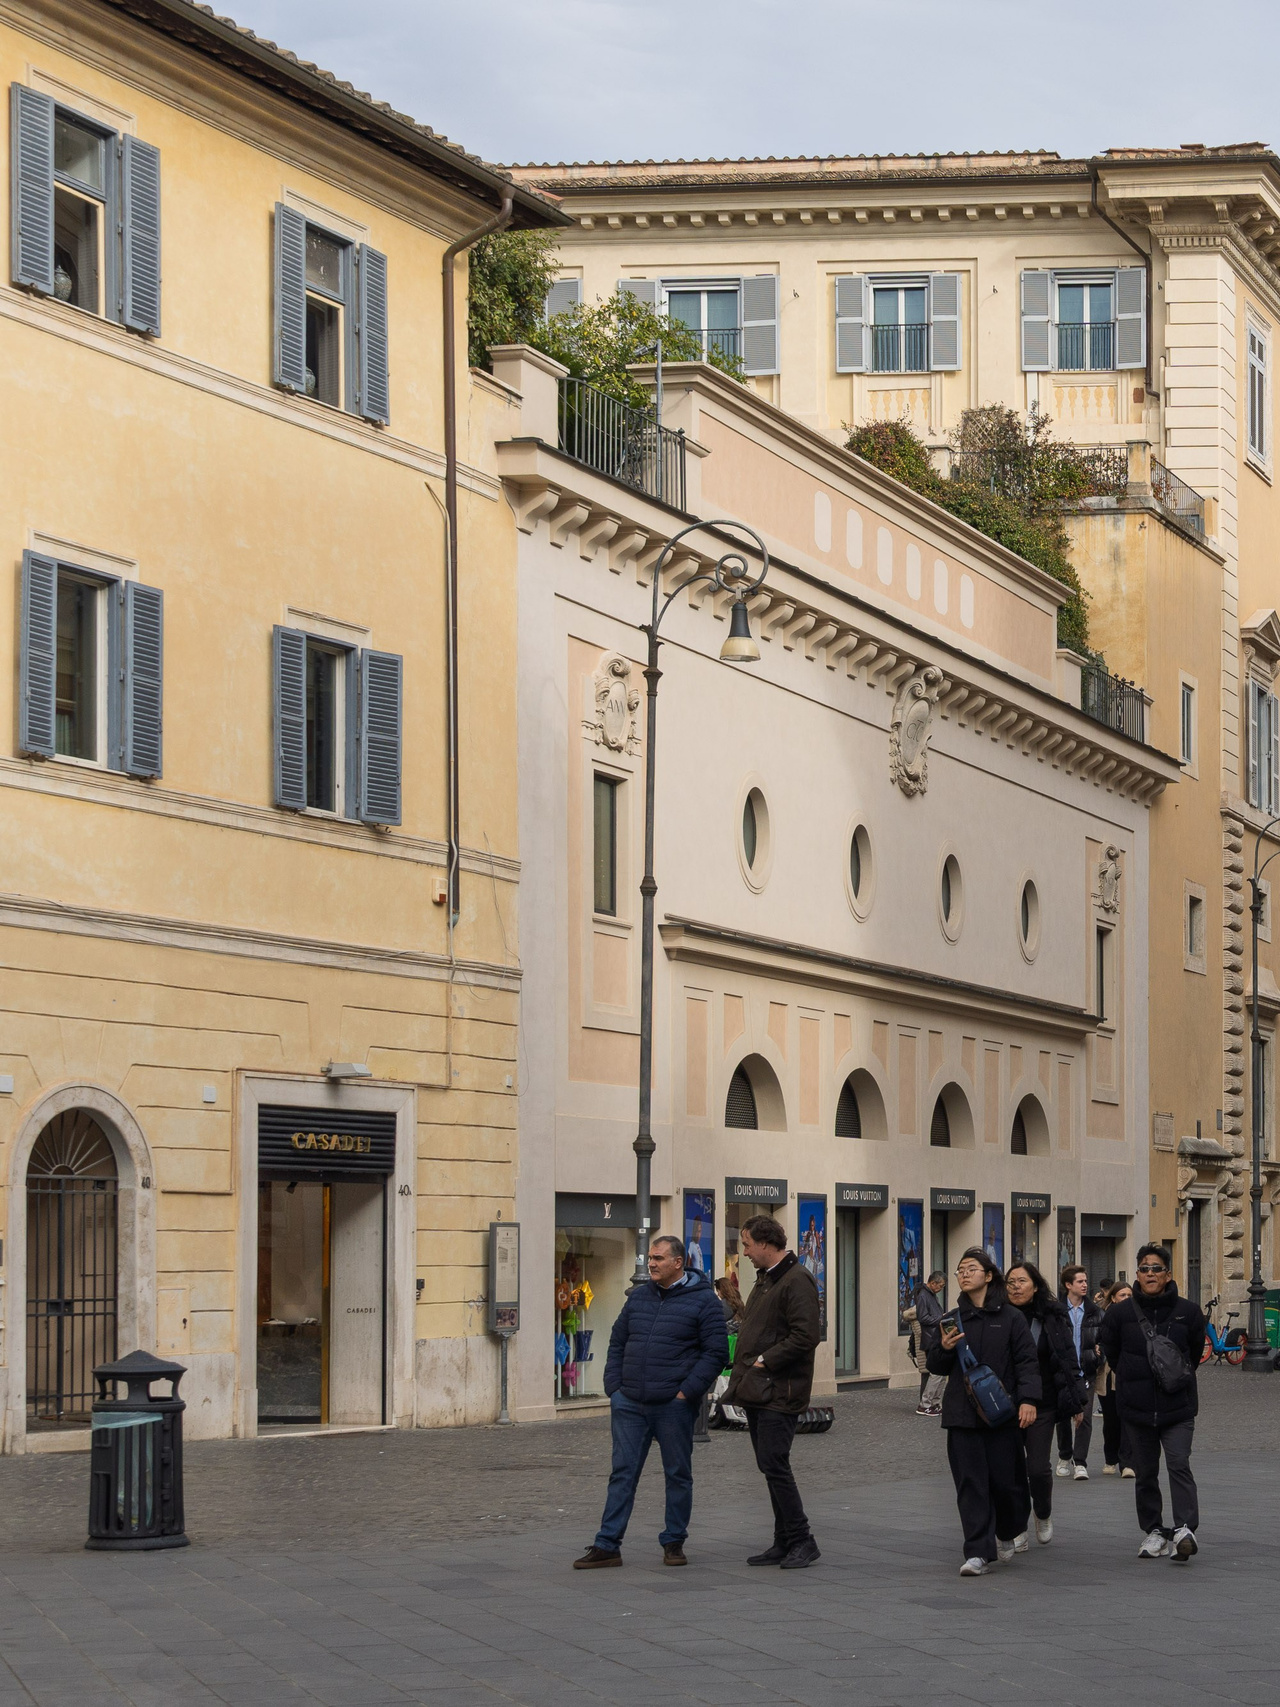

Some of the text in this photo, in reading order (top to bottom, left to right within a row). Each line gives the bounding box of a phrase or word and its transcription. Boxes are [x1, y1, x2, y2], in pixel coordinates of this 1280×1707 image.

[292, 1132, 371, 1152] CASADEI
[734, 1184, 752, 1196] LOUIS
[754, 1185, 779, 1197] VUITTON
[843, 1190, 858, 1200] LOUIS
[860, 1190, 882, 1201] VUITTON
[936, 1194, 970, 1205] LOUIS VUITTON
[1016, 1198, 1028, 1207] LOUIS
[1029, 1199, 1046, 1208] VUITTON
